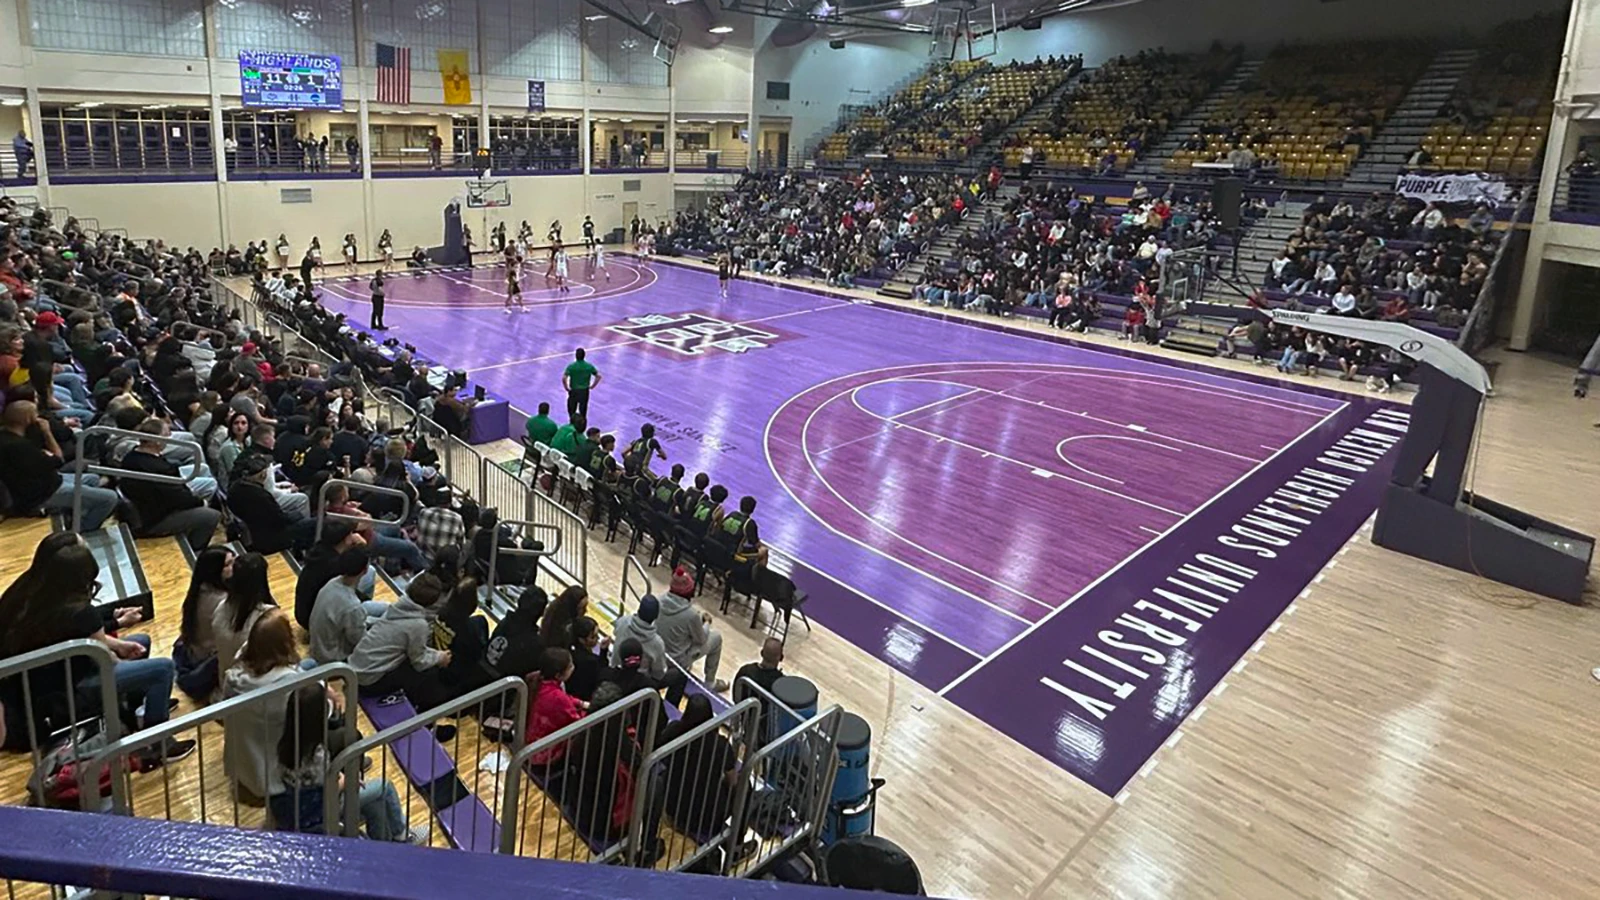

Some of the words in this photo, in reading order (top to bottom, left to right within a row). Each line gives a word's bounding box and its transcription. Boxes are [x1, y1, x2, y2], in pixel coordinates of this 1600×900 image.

[251, 55, 332, 69] HIGHLANDS
[1396, 179, 1452, 195] PURPLE
[1272, 307, 1310, 322] SPALDING
[1363, 408, 1411, 433] NEW
[1316, 427, 1400, 472] MEXICO
[1217, 467, 1355, 559] HIGHLANDS
[1039, 553, 1259, 721] UNIVERSITY
